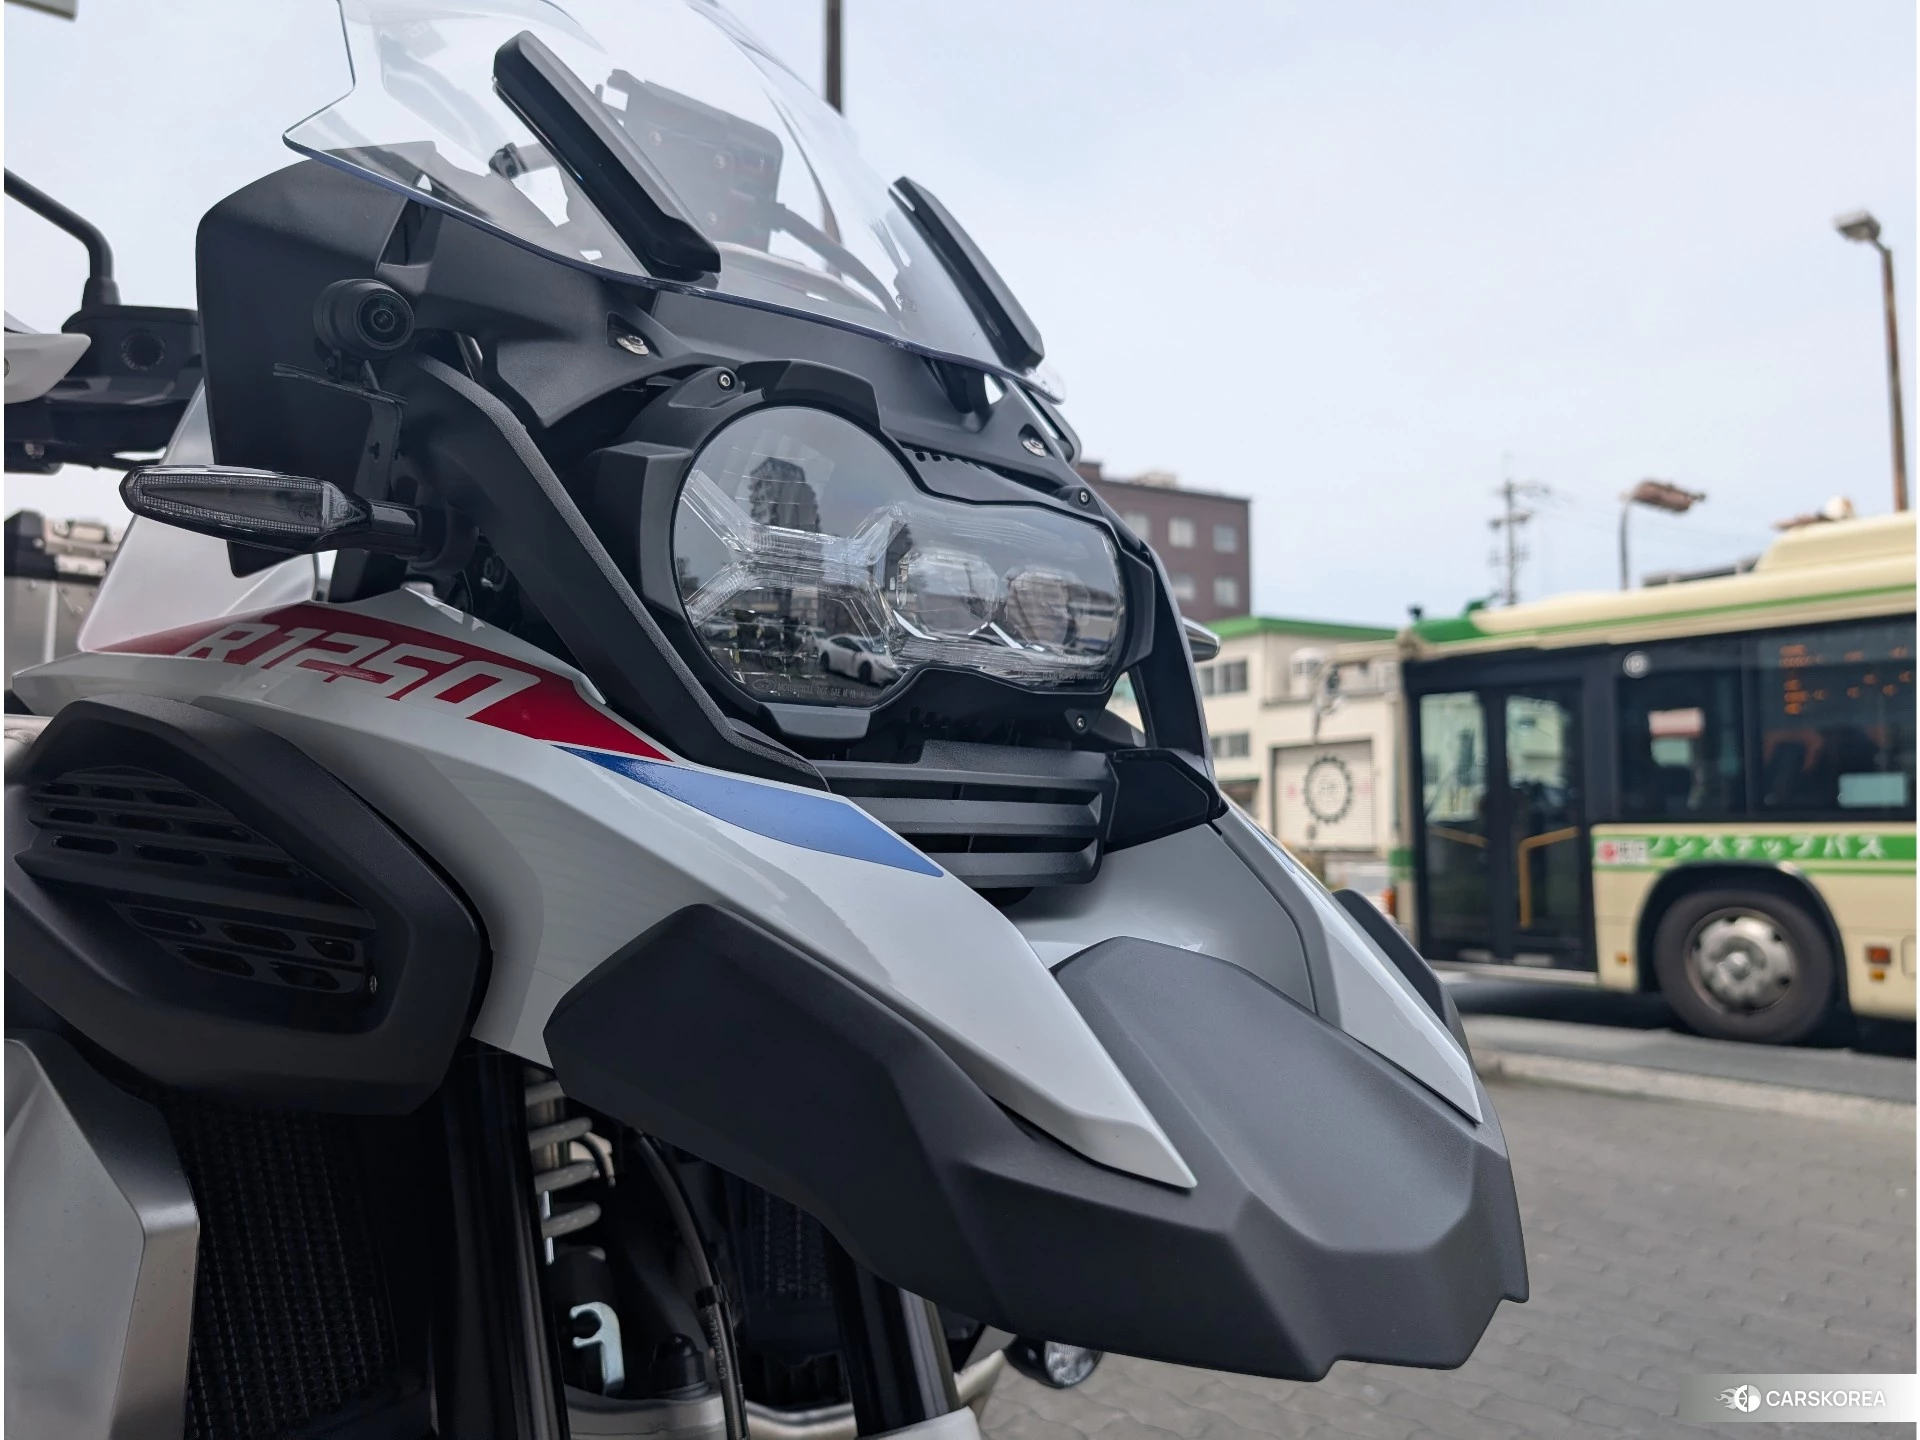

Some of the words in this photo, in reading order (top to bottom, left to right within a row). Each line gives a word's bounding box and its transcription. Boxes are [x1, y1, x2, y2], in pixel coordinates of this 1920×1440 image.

[178, 622, 542, 720] R1250
[1651, 834, 1886, 859] ノンステップバス
